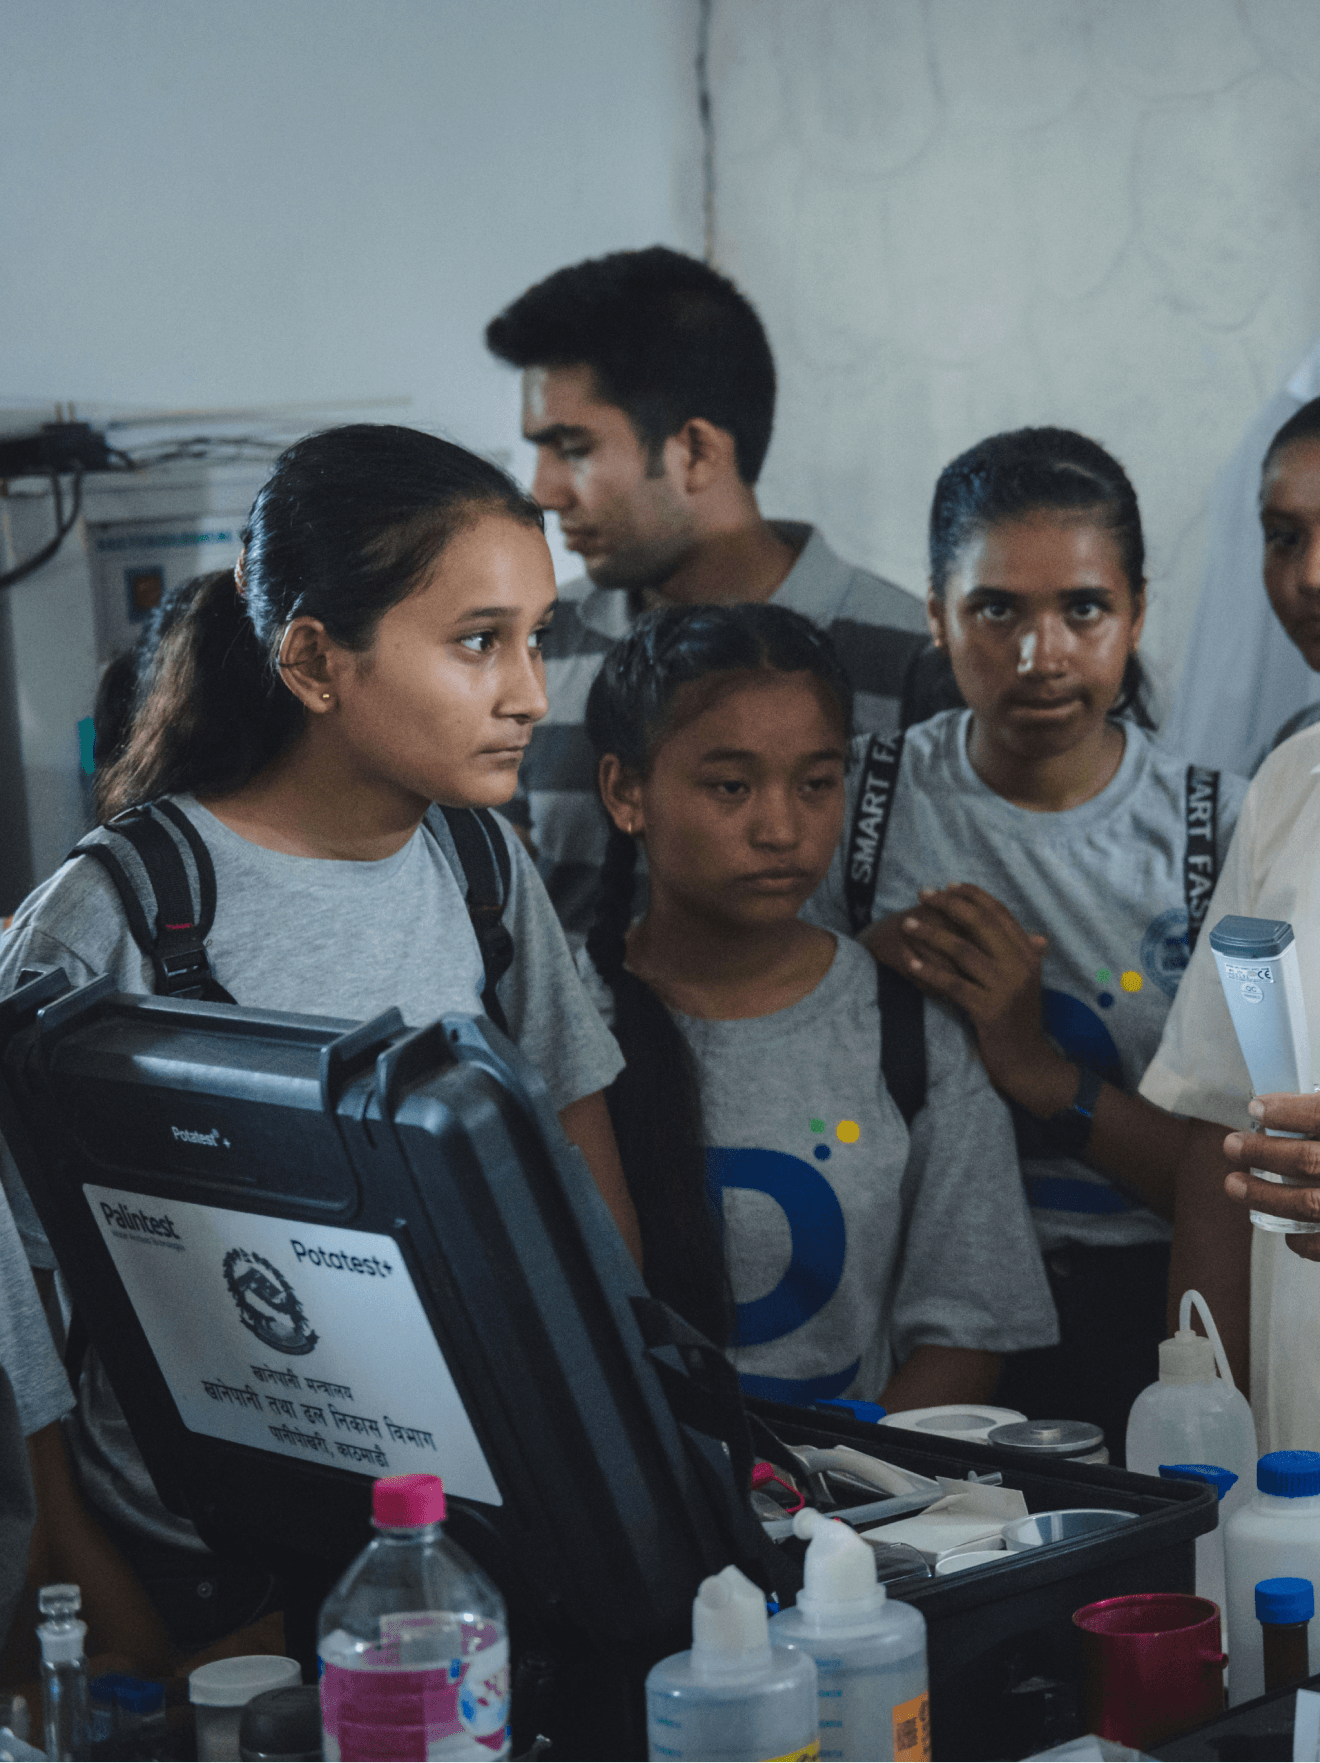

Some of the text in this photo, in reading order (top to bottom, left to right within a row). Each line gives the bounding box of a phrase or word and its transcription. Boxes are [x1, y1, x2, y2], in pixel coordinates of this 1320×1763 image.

[851, 777, 891, 884] SMART
[100, 1201, 181, 1240] Palintest
[289, 1238, 393, 1279] Potatest+
[265, 1395, 298, 1420] तथा
[327, 1402, 383, 1439] निकास
[383, 1414, 438, 1451] विभाग
